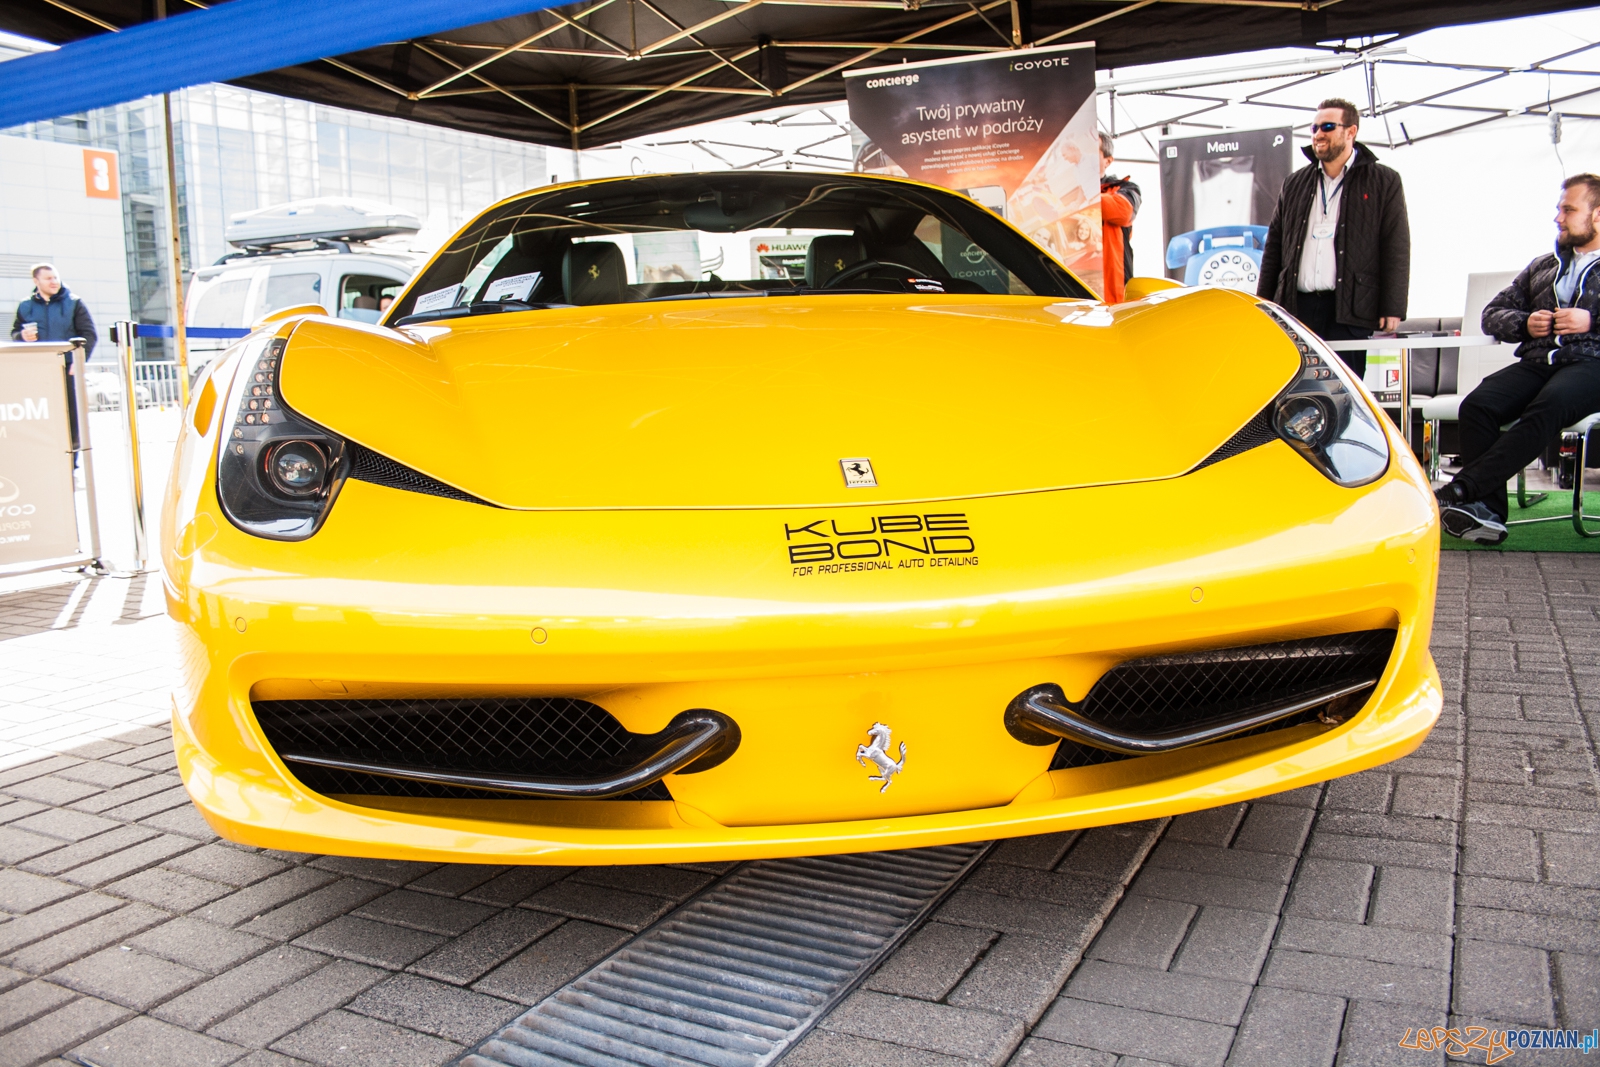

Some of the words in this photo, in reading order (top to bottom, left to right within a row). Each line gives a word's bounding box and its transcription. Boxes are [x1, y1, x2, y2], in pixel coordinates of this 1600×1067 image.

[1009, 58, 1070, 72] iCOYOTE
[866, 73, 920, 89] concierge
[916, 103, 951, 122] Twój
[955, 97, 1026, 120] prywatny
[901, 124, 962, 147] asystent
[964, 123, 979, 137] w
[982, 115, 1044, 139] podróży
[1207, 140, 1239, 154] Menu
[784, 513, 970, 541] KUBE
[788, 535, 976, 565] BOND
[792, 566, 813, 578] FOR
[817, 560, 894, 575] PROFESSIONAL
[898, 558, 925, 570] AUTO
[930, 556, 979, 567] DETAILING
